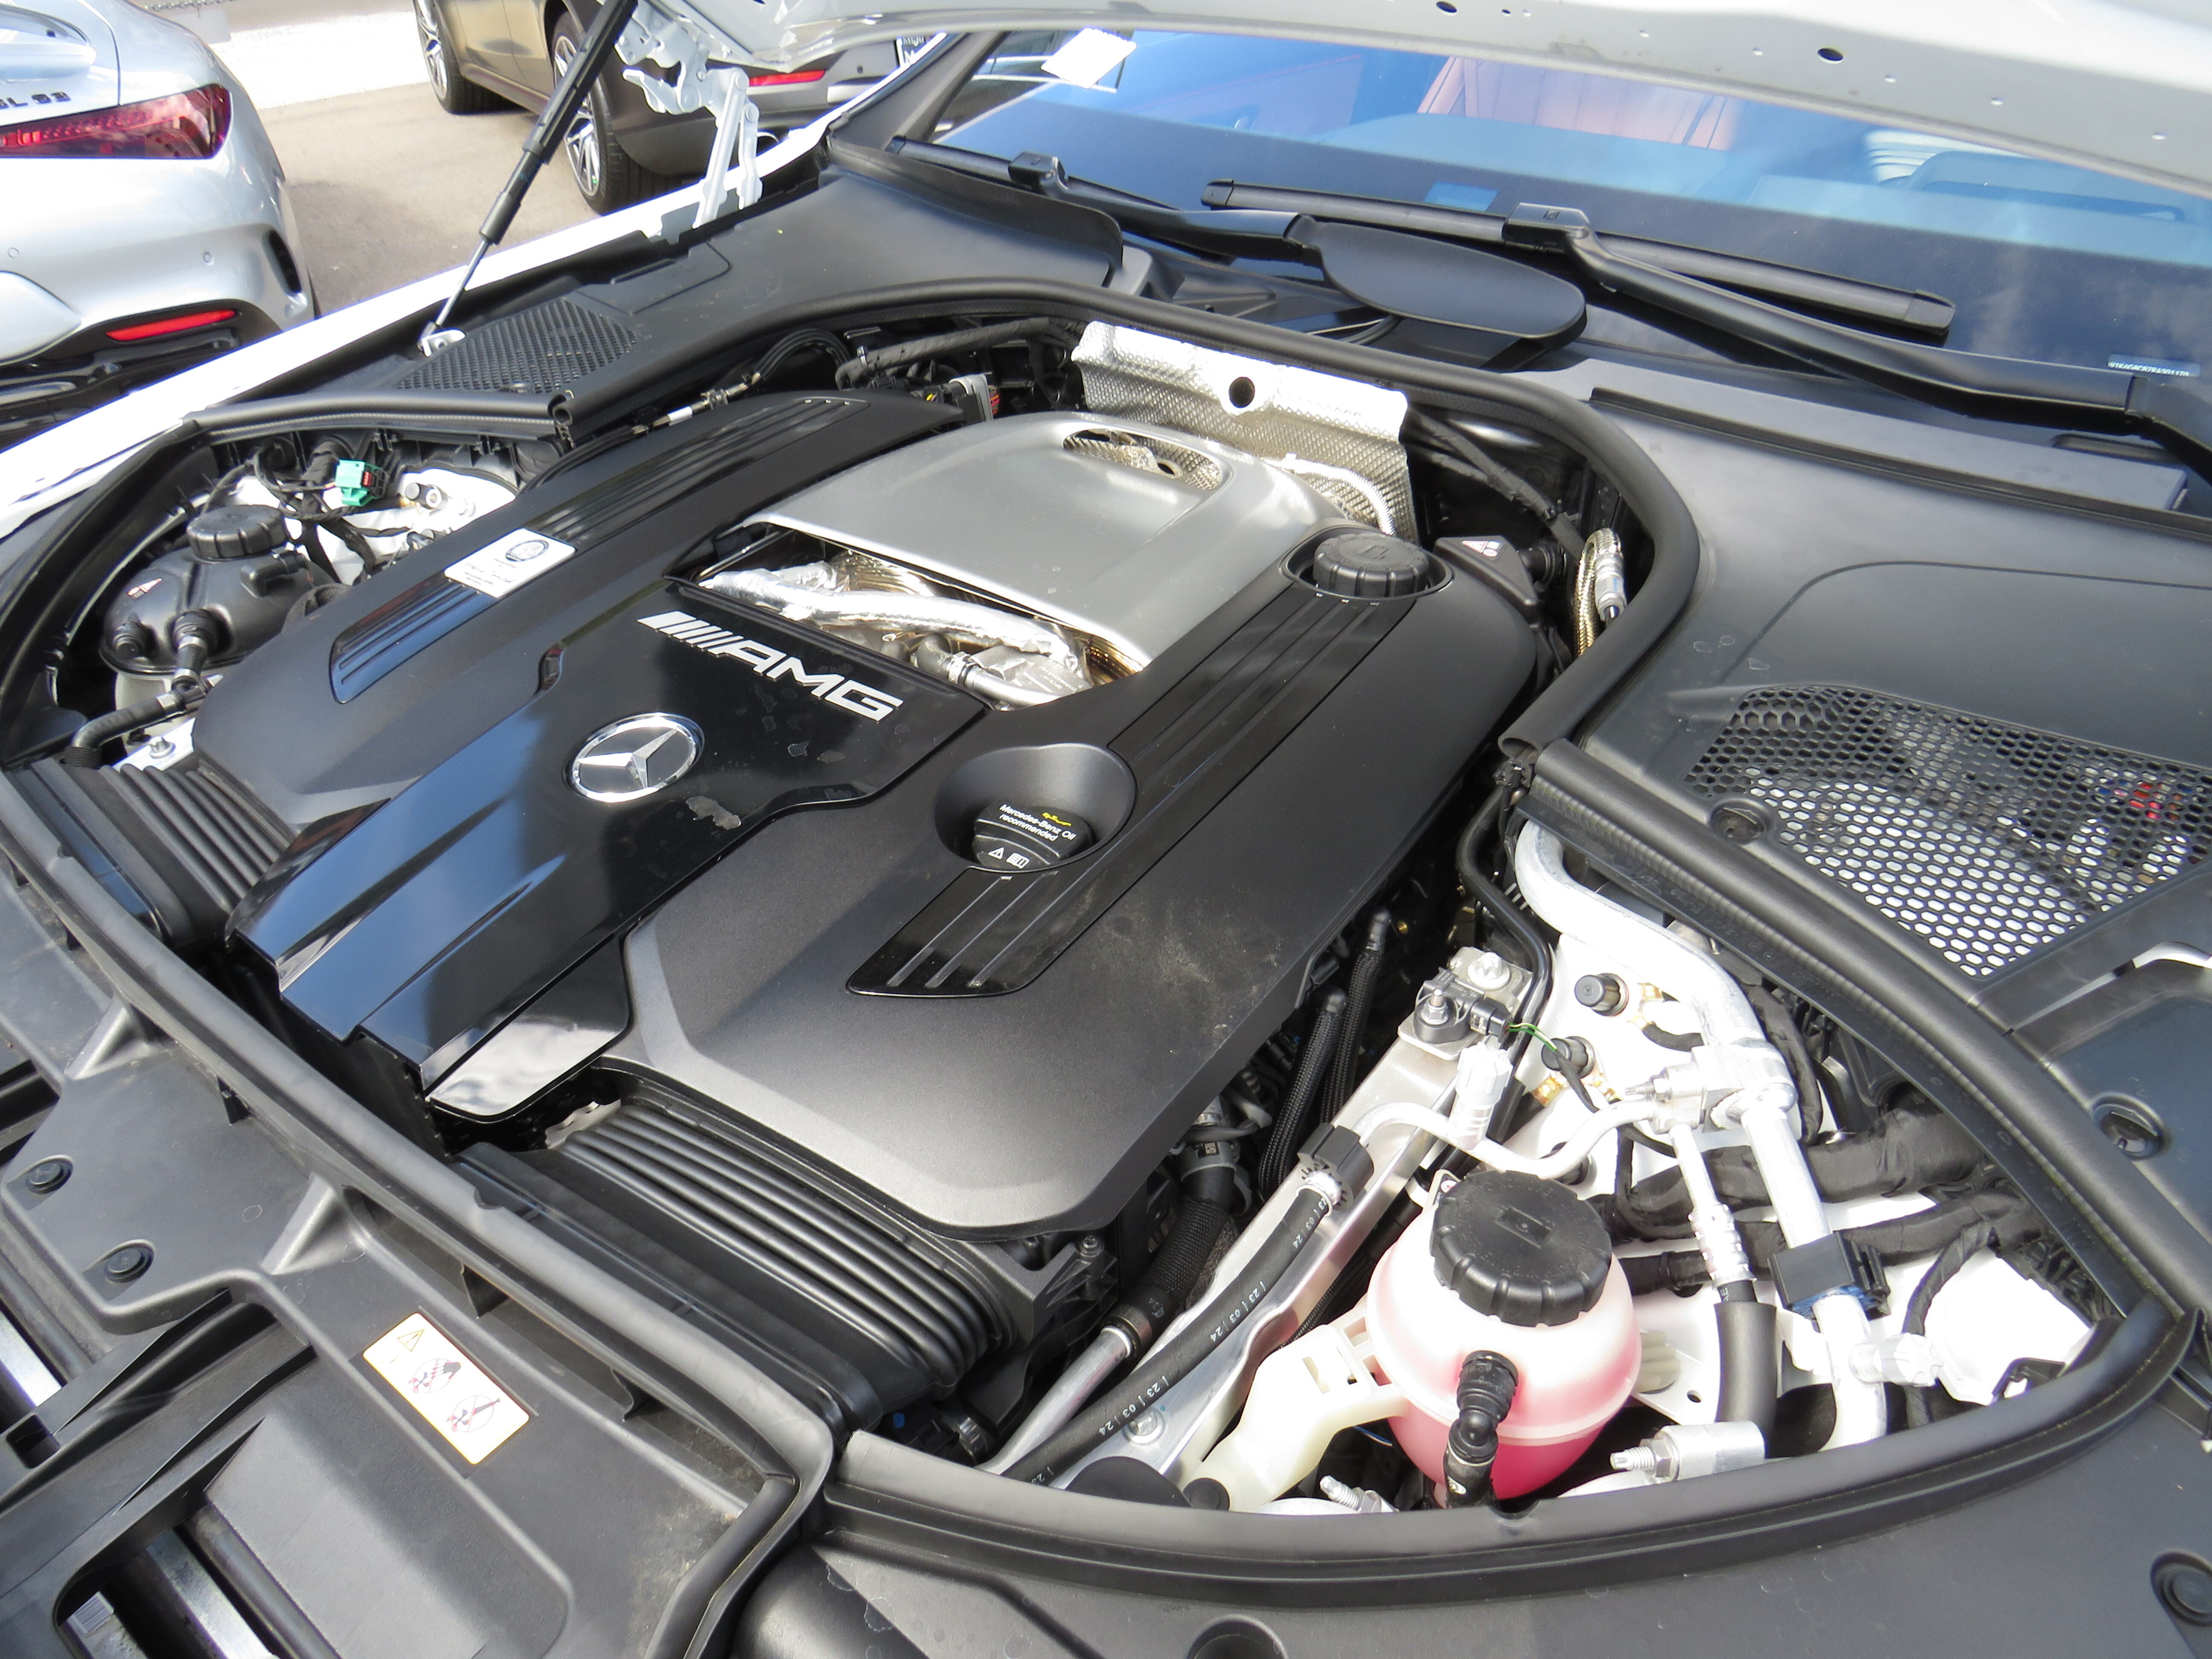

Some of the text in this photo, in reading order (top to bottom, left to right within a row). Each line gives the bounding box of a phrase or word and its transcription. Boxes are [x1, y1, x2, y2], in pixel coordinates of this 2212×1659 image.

[707, 639, 904, 722] AMG
[999, 804, 1077, 841] Mercedes-Benz Oil
[999, 814, 1059, 842] recommended
[1210, 1287, 1260, 1342] 23 03 24
[1098, 1382, 1161, 1436] 23 03 24
